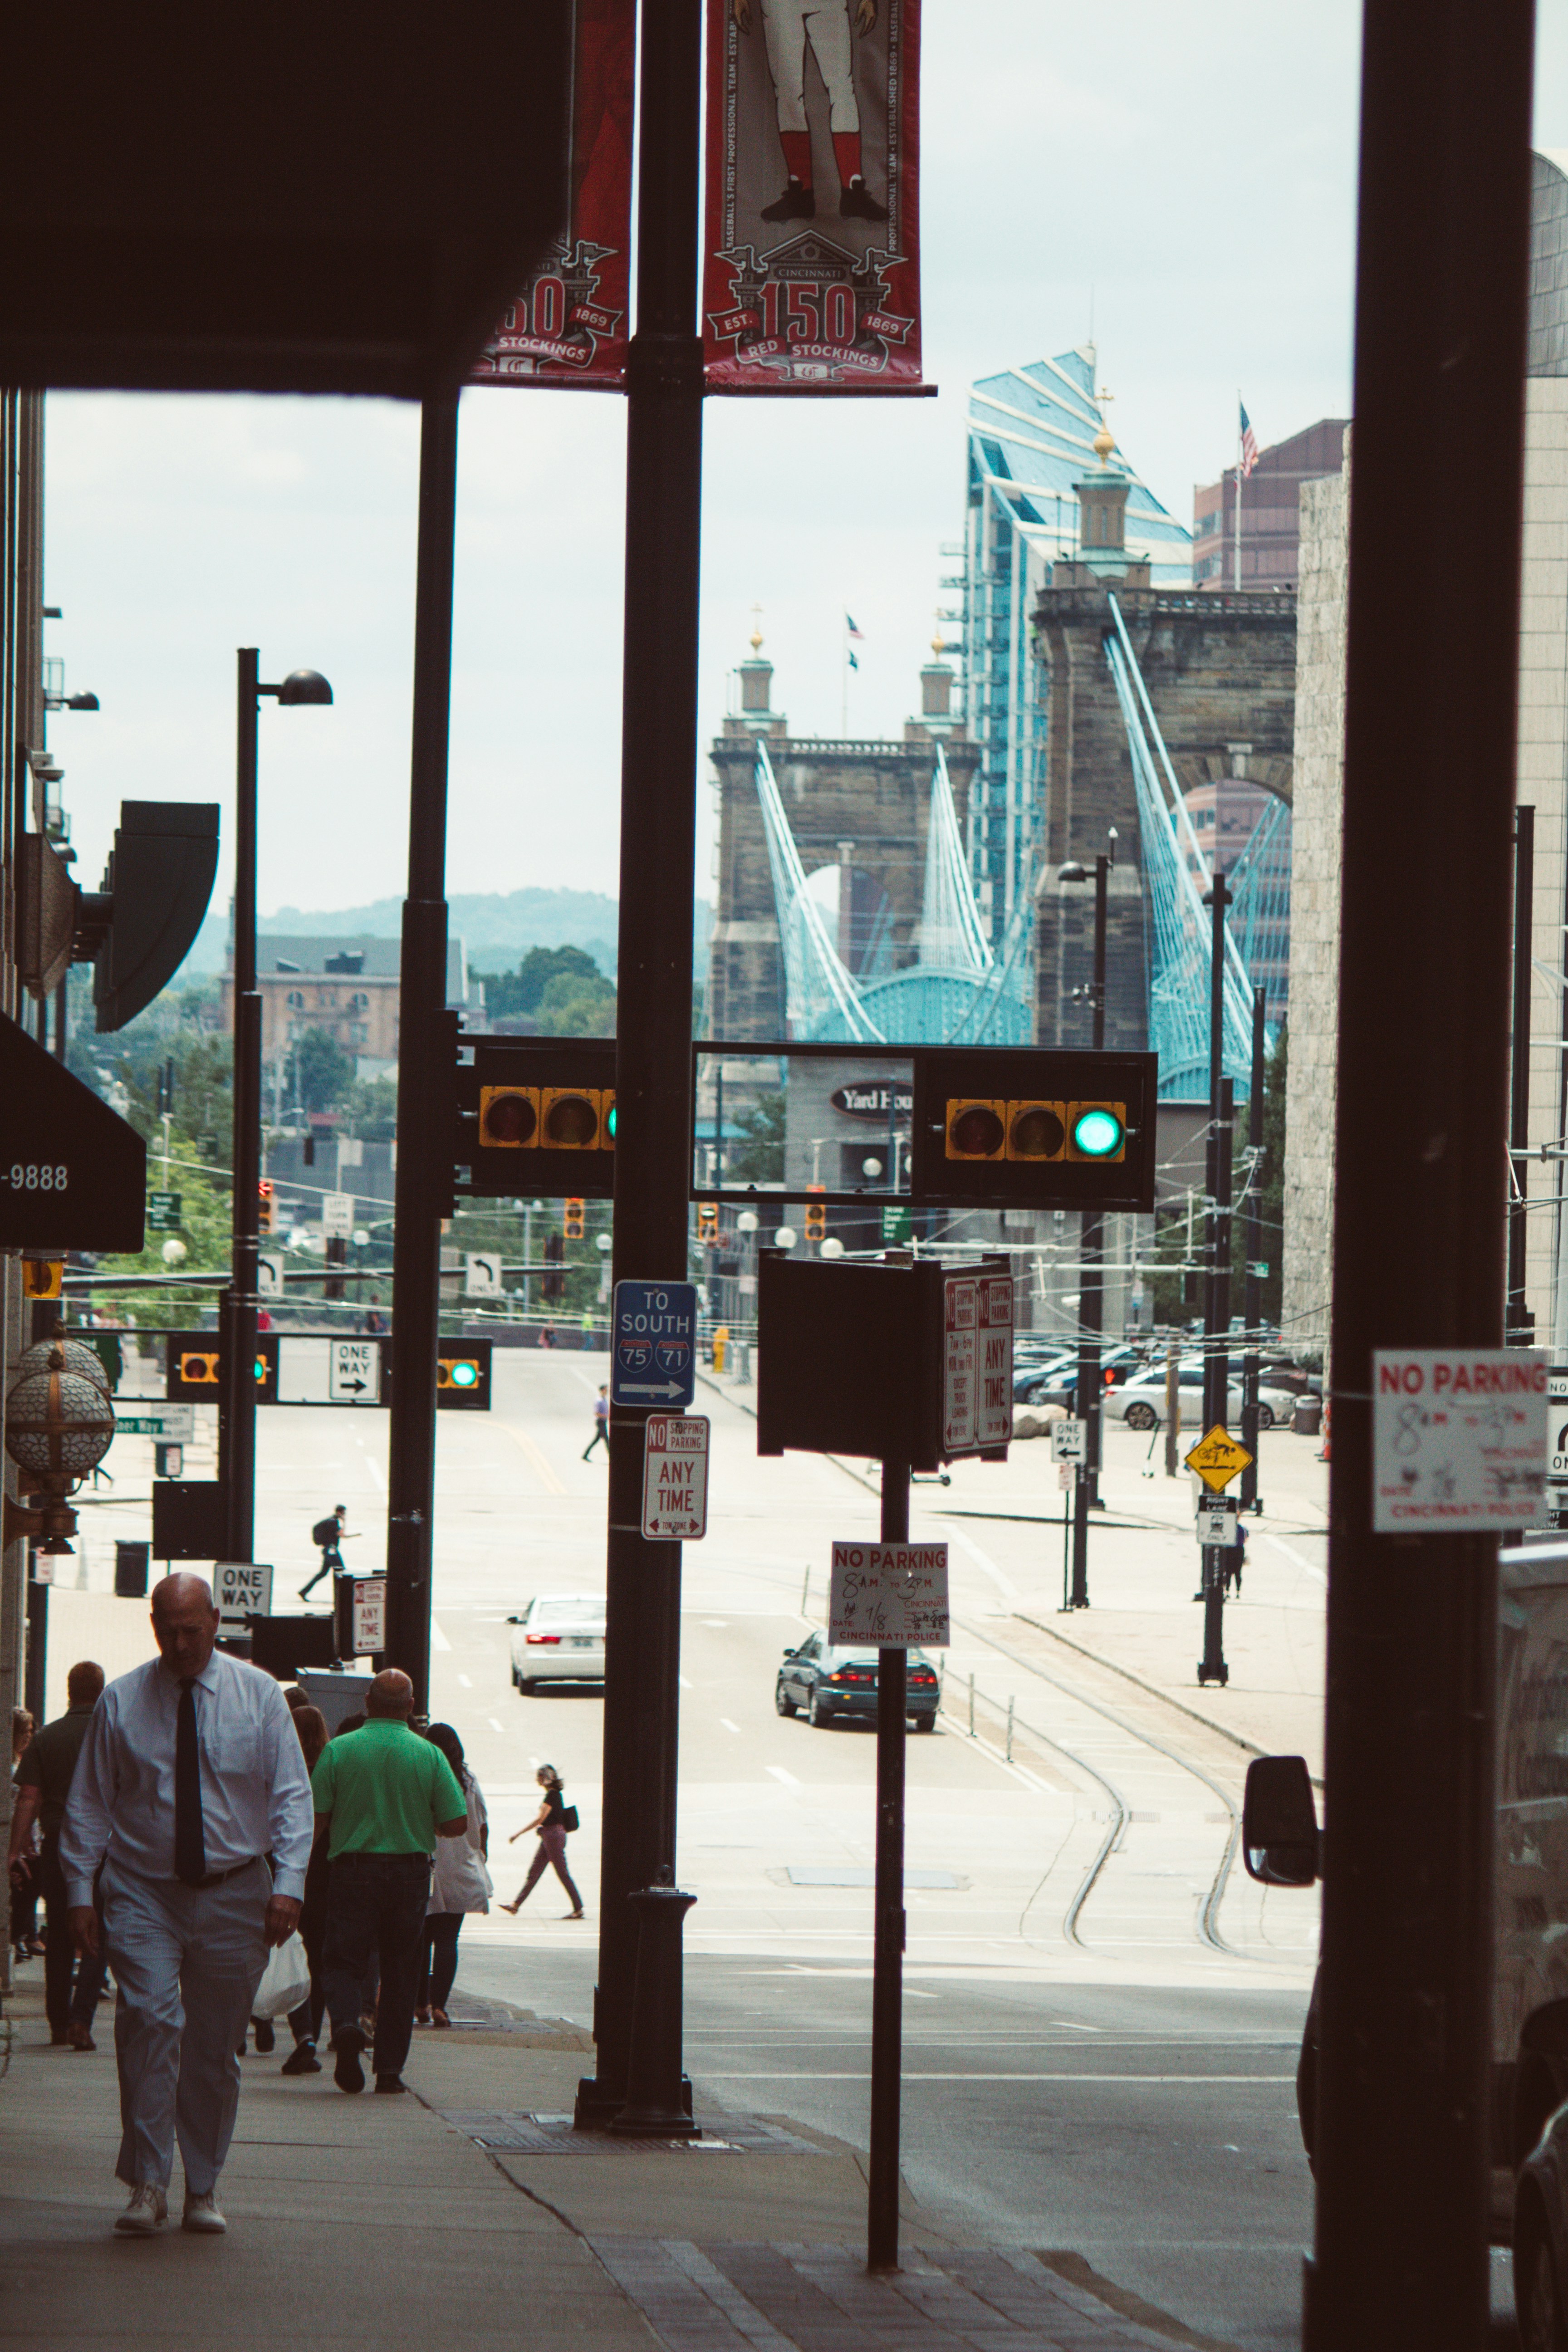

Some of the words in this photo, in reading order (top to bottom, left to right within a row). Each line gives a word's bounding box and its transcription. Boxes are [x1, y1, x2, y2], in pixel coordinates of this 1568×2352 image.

[890, 52, 898, 76] 1869
[889, 78, 898, 145] ESTABLISHED
[728, 93, 736, 163] PROFESSIONAL
[888, 182, 897, 251] PROFESSIONAL
[779, 268, 842, 278] CINCINNATI
[575, 307, 608, 328] 1869
[724, 314, 753, 331] EST.
[758, 281, 856, 346] 150
[867, 315, 899, 334] 1869
[499, 337, 586, 361] STOCKINGS
[747, 340, 779, 358] RED
[792, 344, 879, 368] STOCKINGS
[843, 1089, 878, 1110] Yard
[644, 1292, 668, 1310] TO
[991, 1285, 1010, 1302] STOPPING
[991, 1304, 1009, 1321] PARKING
[621, 1313, 689, 1334] SOUTH
[339, 1345, 370, 1359] ONE
[623, 1348, 646, 1365] 75
[662, 1350, 681, 1367] 71
[985, 1339, 1005, 1370] ANY
[338, 1362, 371, 1375] WAY
[1379, 1362, 1425, 1396] NO
[985, 1377, 1005, 1408] TIME
[648, 1424, 666, 1447] NO
[670, 1422, 704, 1435] STOPPING
[1057, 1424, 1080, 1435] ONE
[671, 1436, 701, 1449] PARKING
[1057, 1436, 1080, 1445] WAY
[659, 1461, 694, 1484] ANY
[658, 1490, 694, 1512] TIME
[1206, 1497, 1230, 1505] RIGHT
[1206, 1504, 1229, 1513] LANE
[835, 1549, 864, 1568] NO
[870, 1550, 947, 1569] PARKING
[224, 1569, 263, 1587] ONE
[221, 1588, 263, 1607] WAY
[904, 1600, 947, 1608] CINCINNATI
[362, 1607, 378, 1620] ANY
[361, 1622, 379, 1636] TIME
[839, 1632, 903, 1642] CINCINNATI
[907, 1632, 941, 1642] POLICE
